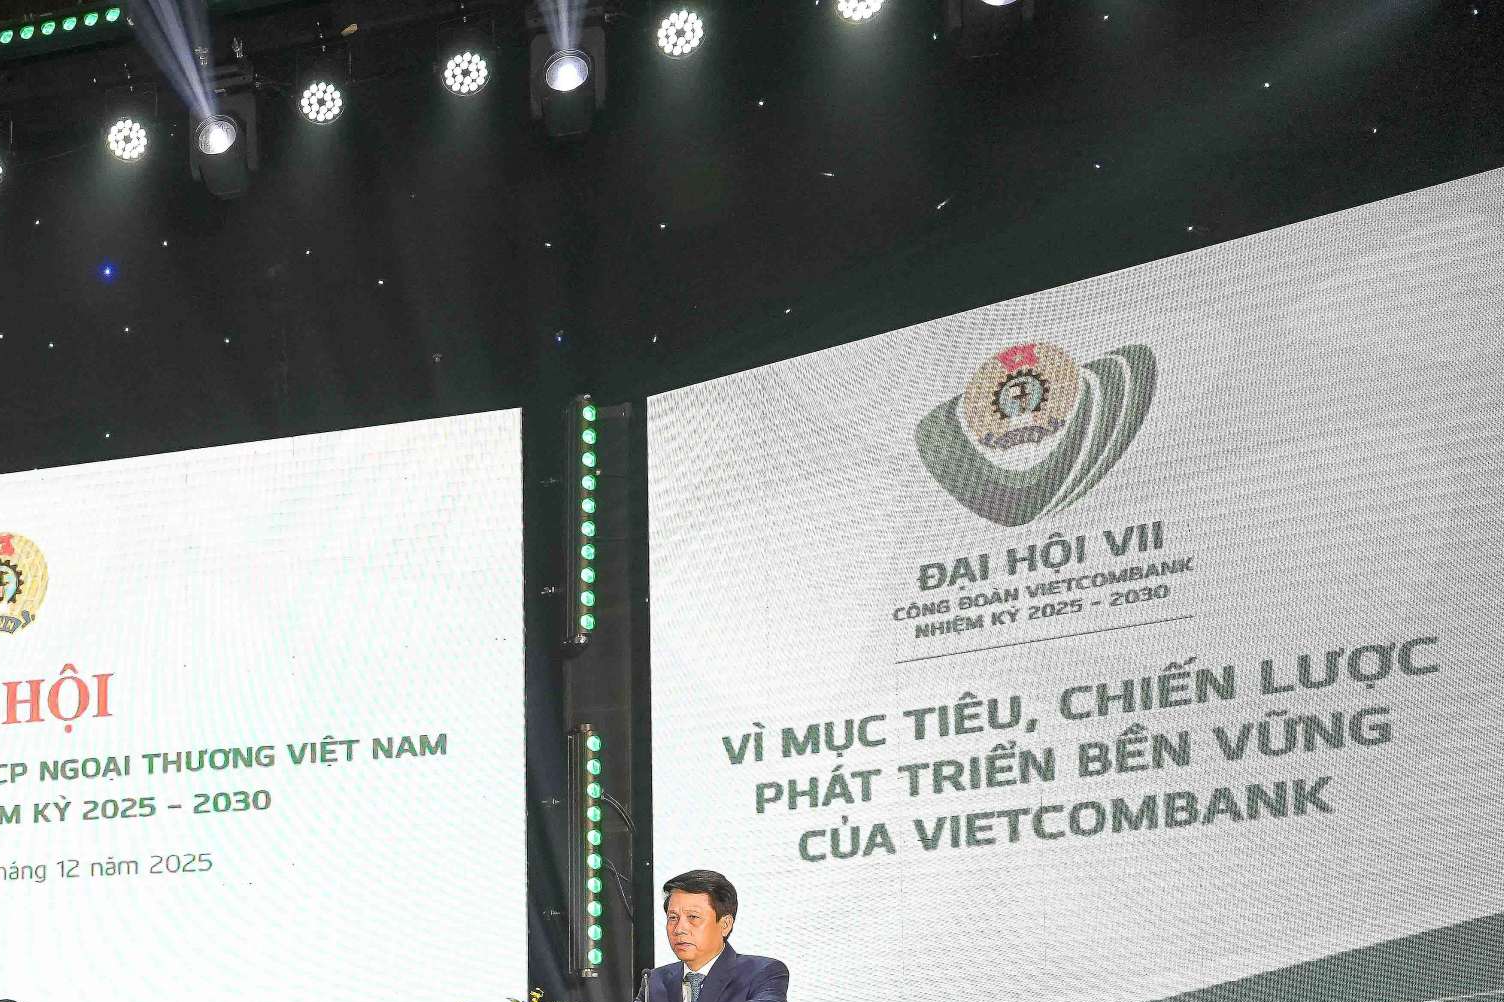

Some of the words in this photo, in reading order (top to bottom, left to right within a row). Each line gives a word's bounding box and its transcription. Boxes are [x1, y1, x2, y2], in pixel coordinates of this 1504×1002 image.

[893, 599, 951, 621] CÔNG
[958, 586, 1019, 610] ĐOÀN
[1025, 556, 1194, 599] VIETCOMBANK
[917, 553, 990, 592] ĐẠI
[1007, 531, 1087, 576] HỘI
[1103, 520, 1164, 557] VII
[915, 614, 984, 640] NHIỆM
[1027, 598, 1083, 620] 2025
[1109, 583, 1171, 608] 2030
[1, 663, 114, 734] HỘI
[721, 721, 763, 766] VÌ
[780, 713, 888, 760] MỤC
[902, 691, 1039, 742] TIÊU,
[1058, 655, 1237, 724] CHIẾN
[1259, 636, 1441, 697] LƯỢC
[39, 754, 130, 782] NGOẠI
[142, 743, 275, 776] THƯƠNG
[286, 734, 360, 767] VIỆT
[372, 732, 447, 761] NAM
[754, 766, 882, 814] PHÁT
[898, 739, 1056, 799] TRIỂN
[1078, 721, 1192, 778] BỀN
[1212, 704, 1393, 763] VỮNG
[32, 794, 72, 825] KỲ
[82, 796, 156, 821] 2025
[193, 789, 272, 815] 2030
[798, 813, 897, 863] CỦA
[914, 774, 1335, 851] VIETCOMBANK
[56, 858, 80, 879] 12
[90, 856, 139, 877] năm
[149, 852, 213, 875] 2025
